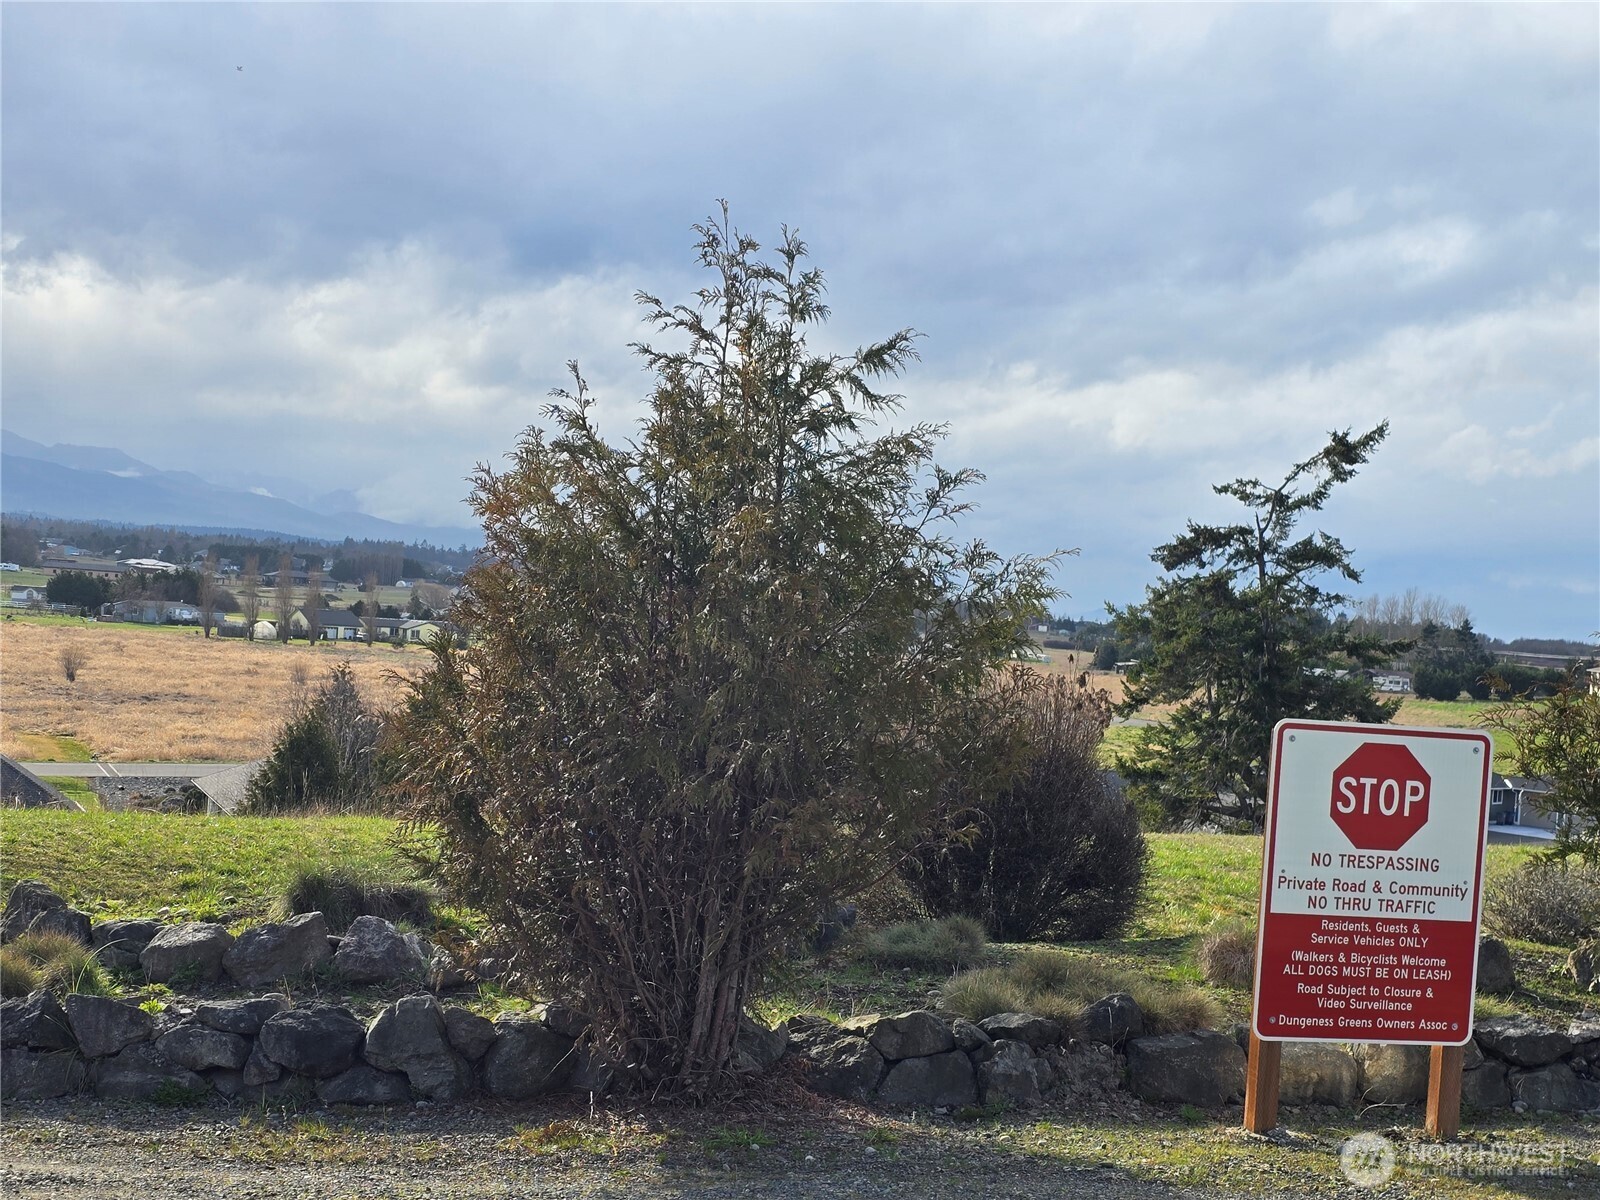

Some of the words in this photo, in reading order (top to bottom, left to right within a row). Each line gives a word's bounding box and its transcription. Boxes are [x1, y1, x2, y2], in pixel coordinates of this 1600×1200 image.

[1336, 776, 1425, 816] STOP
[1311, 853, 1332, 866] NO
[1340, 854, 1440, 872] TRESPASSING
[1278, 876, 1326, 891] Private
[1333, 880, 1366, 893] Road
[1372, 881, 1382, 893] &
[1389, 882, 1468, 901] Community
[1308, 896, 1327, 910] NO
[1334, 897, 1371, 911] THRU
[1378, 899, 1435, 914] TRAFFIC
[1376, 922, 1408, 933] Guests
[1412, 923, 1420, 934] &
[1311, 934, 1349, 945] Service
[1353, 935, 1395, 947] Vehicles
[1399, 937, 1428, 948] ONLY
[1291, 951, 1334, 964] (Walkers
[1338, 953, 1346, 963] &
[1350, 953, 1398, 966] Bicyclists
[1401, 955, 1446, 966] Welcome
[1283, 964, 1305, 975] ALL
[1308, 966, 1338, 977] DOGS
[1342, 967, 1371, 978] MUST
[1375, 968, 1389, 979] BE
[1393, 969, 1409, 979] ON
[1413, 969, 1451, 981] LEASH)
[1297, 983, 1323, 994] Road
[1327, 984, 1366, 998] Subject
[1370, 986, 1379, 996] to
[1383, 986, 1422, 997] Closure
[1426, 988, 1433, 998] &
[1317, 998, 1346, 1009] Video
[1349, 999, 1412, 1011] Surveillance
[1279, 1015, 1334, 1029] Dungeness
[1338, 1017, 1373, 1028] Greens
[1376, 1018, 1415, 1029] Owners
[1419, 1019, 1448, 1030] Assoc
